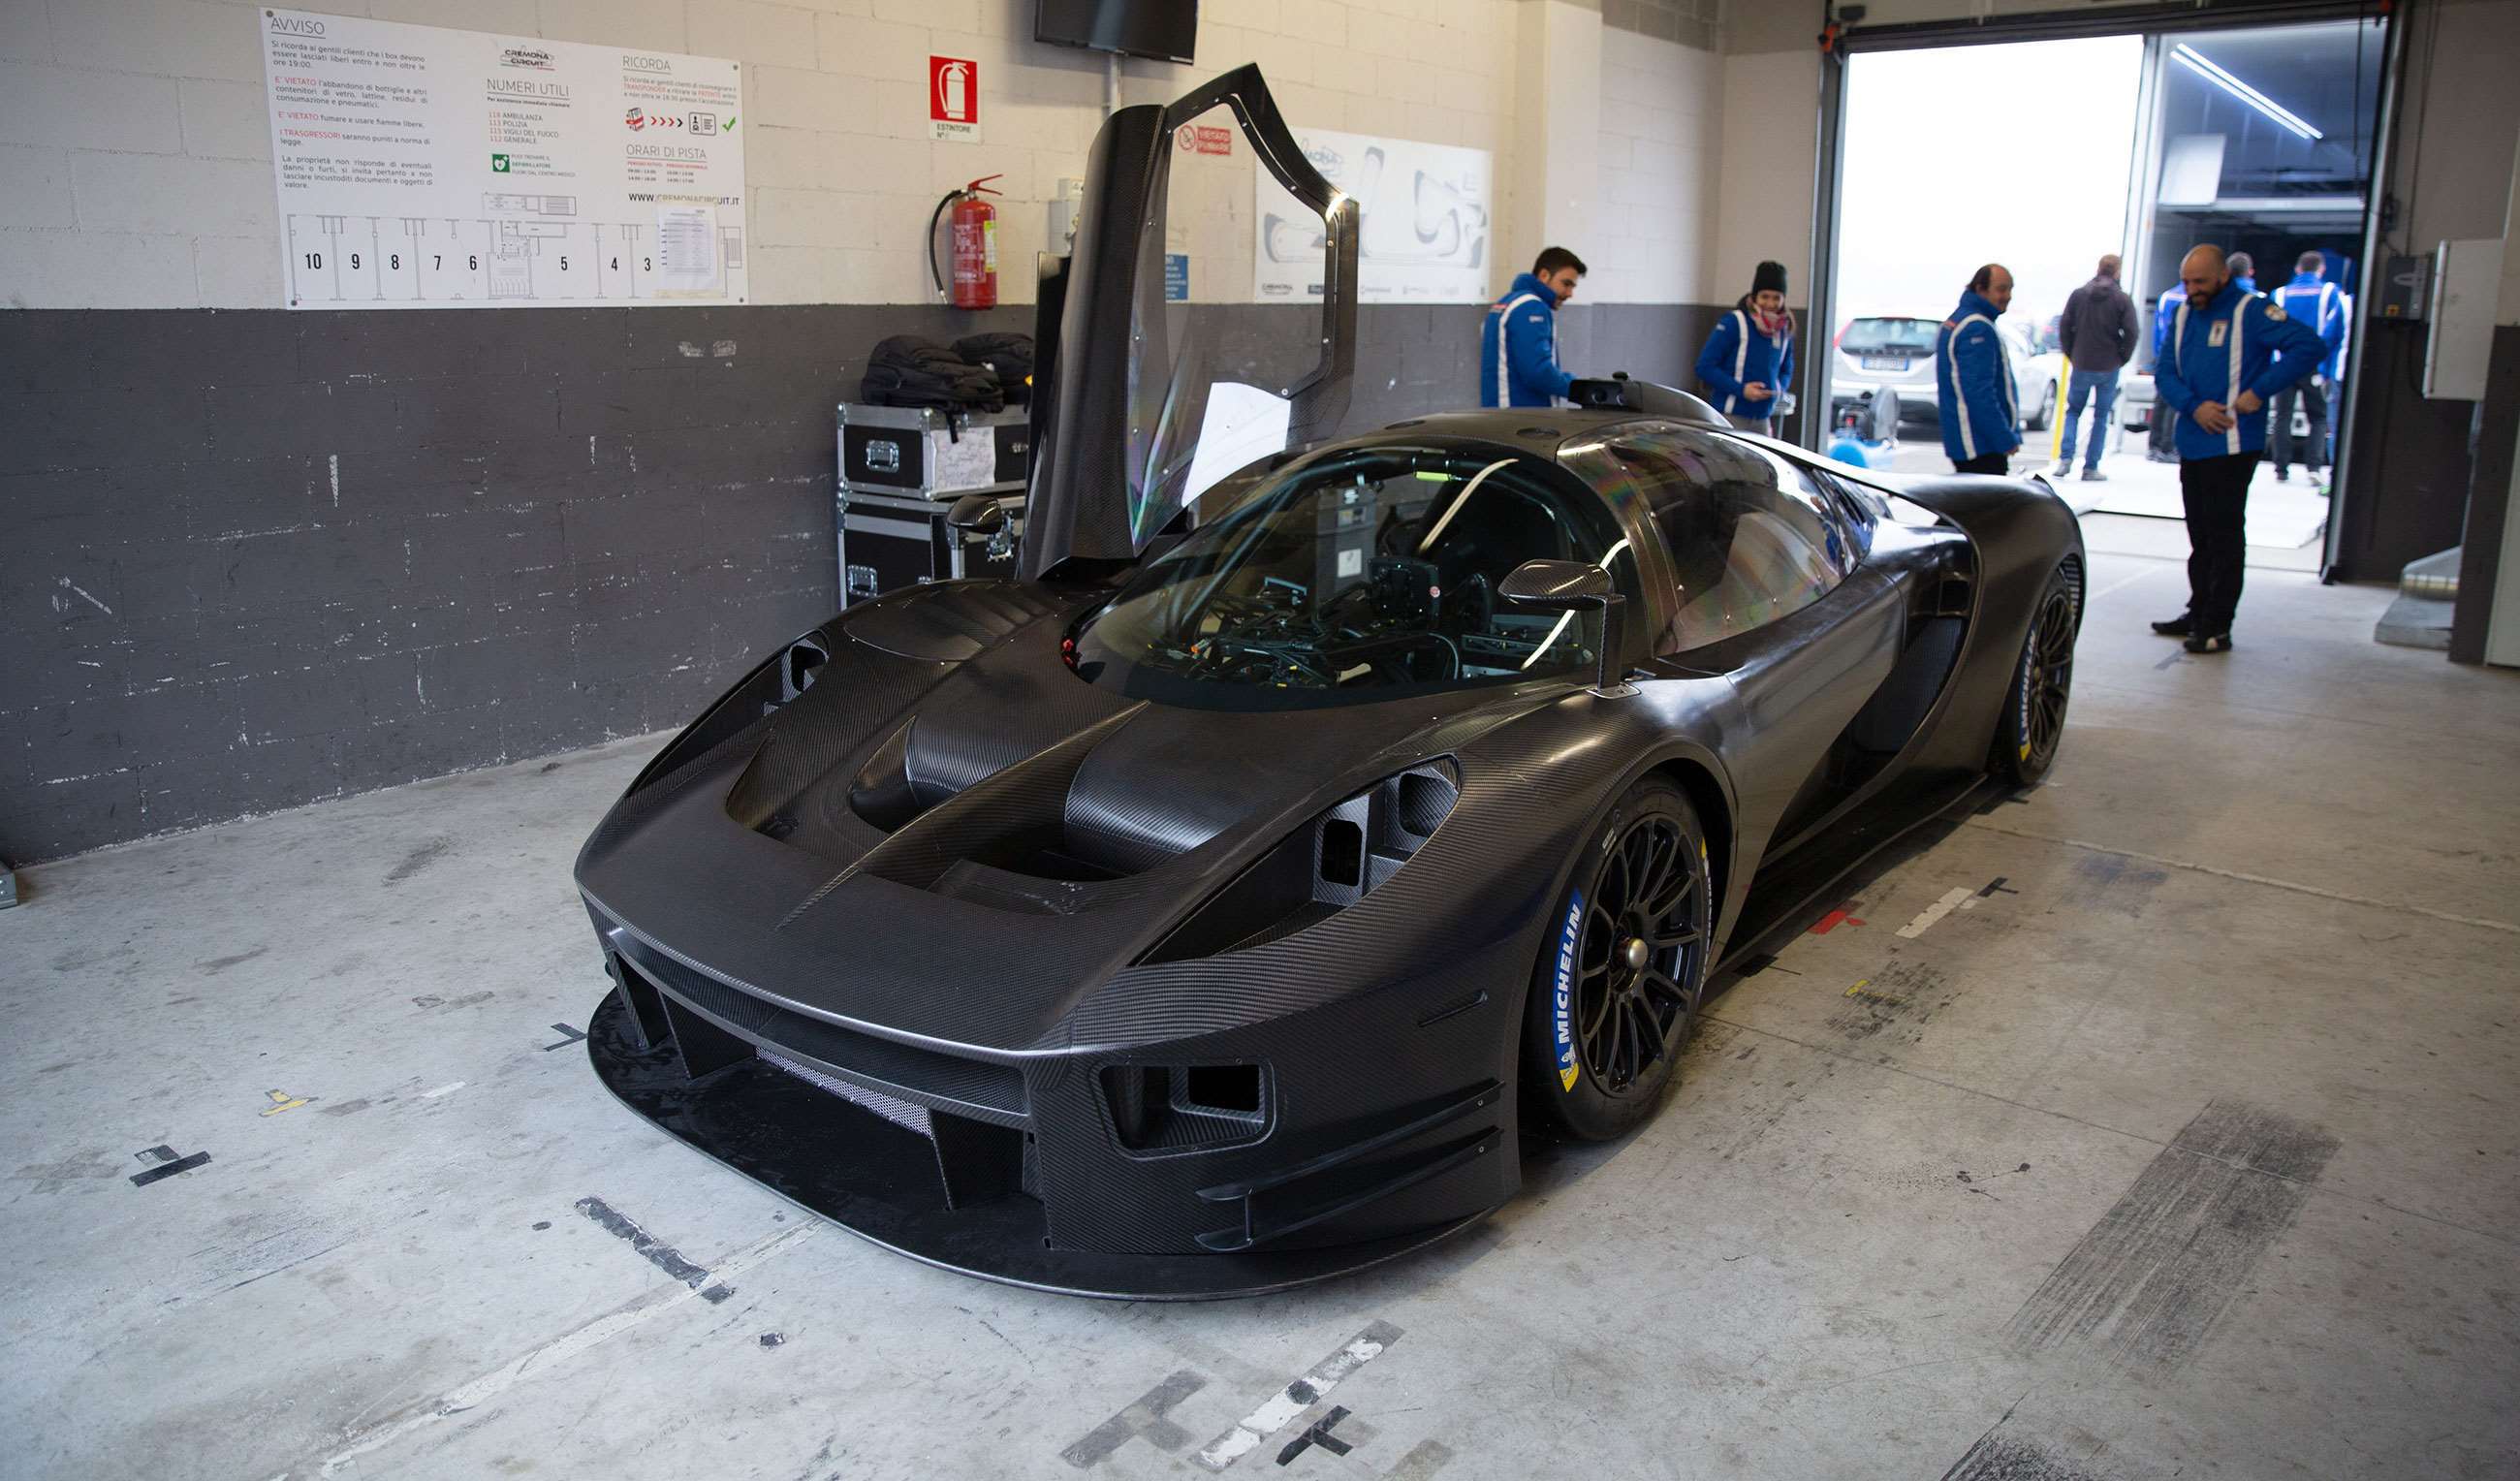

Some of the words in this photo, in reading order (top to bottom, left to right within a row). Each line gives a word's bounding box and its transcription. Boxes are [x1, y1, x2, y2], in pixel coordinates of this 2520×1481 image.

[271, 17, 325, 35] AVVISO
[505, 49, 550, 60] CREMONA
[510, 58, 545, 67] CIRCUIT
[622, 56, 671, 70] RICORDA
[284, 78, 317, 86] VIETATO
[487, 79, 536, 93] NUMERI
[540, 84, 569, 97] UTILI
[503, 112, 543, 121] AMBULANZA
[936, 123, 971, 134] ESTINTORE
[626, 144, 660, 155] ORARI
[678, 148, 706, 159] PISTA
[305, 253, 322, 269] 10
[351, 254, 361, 269] 9
[391, 254, 399, 270] 8
[434, 256, 442, 270] 7
[469, 256, 477, 270] 6
[560, 256, 568, 271] 5
[611, 257, 618, 271] 4
[644, 257, 651, 271] 3
[1557, 903, 1581, 1044] MICHELIN
